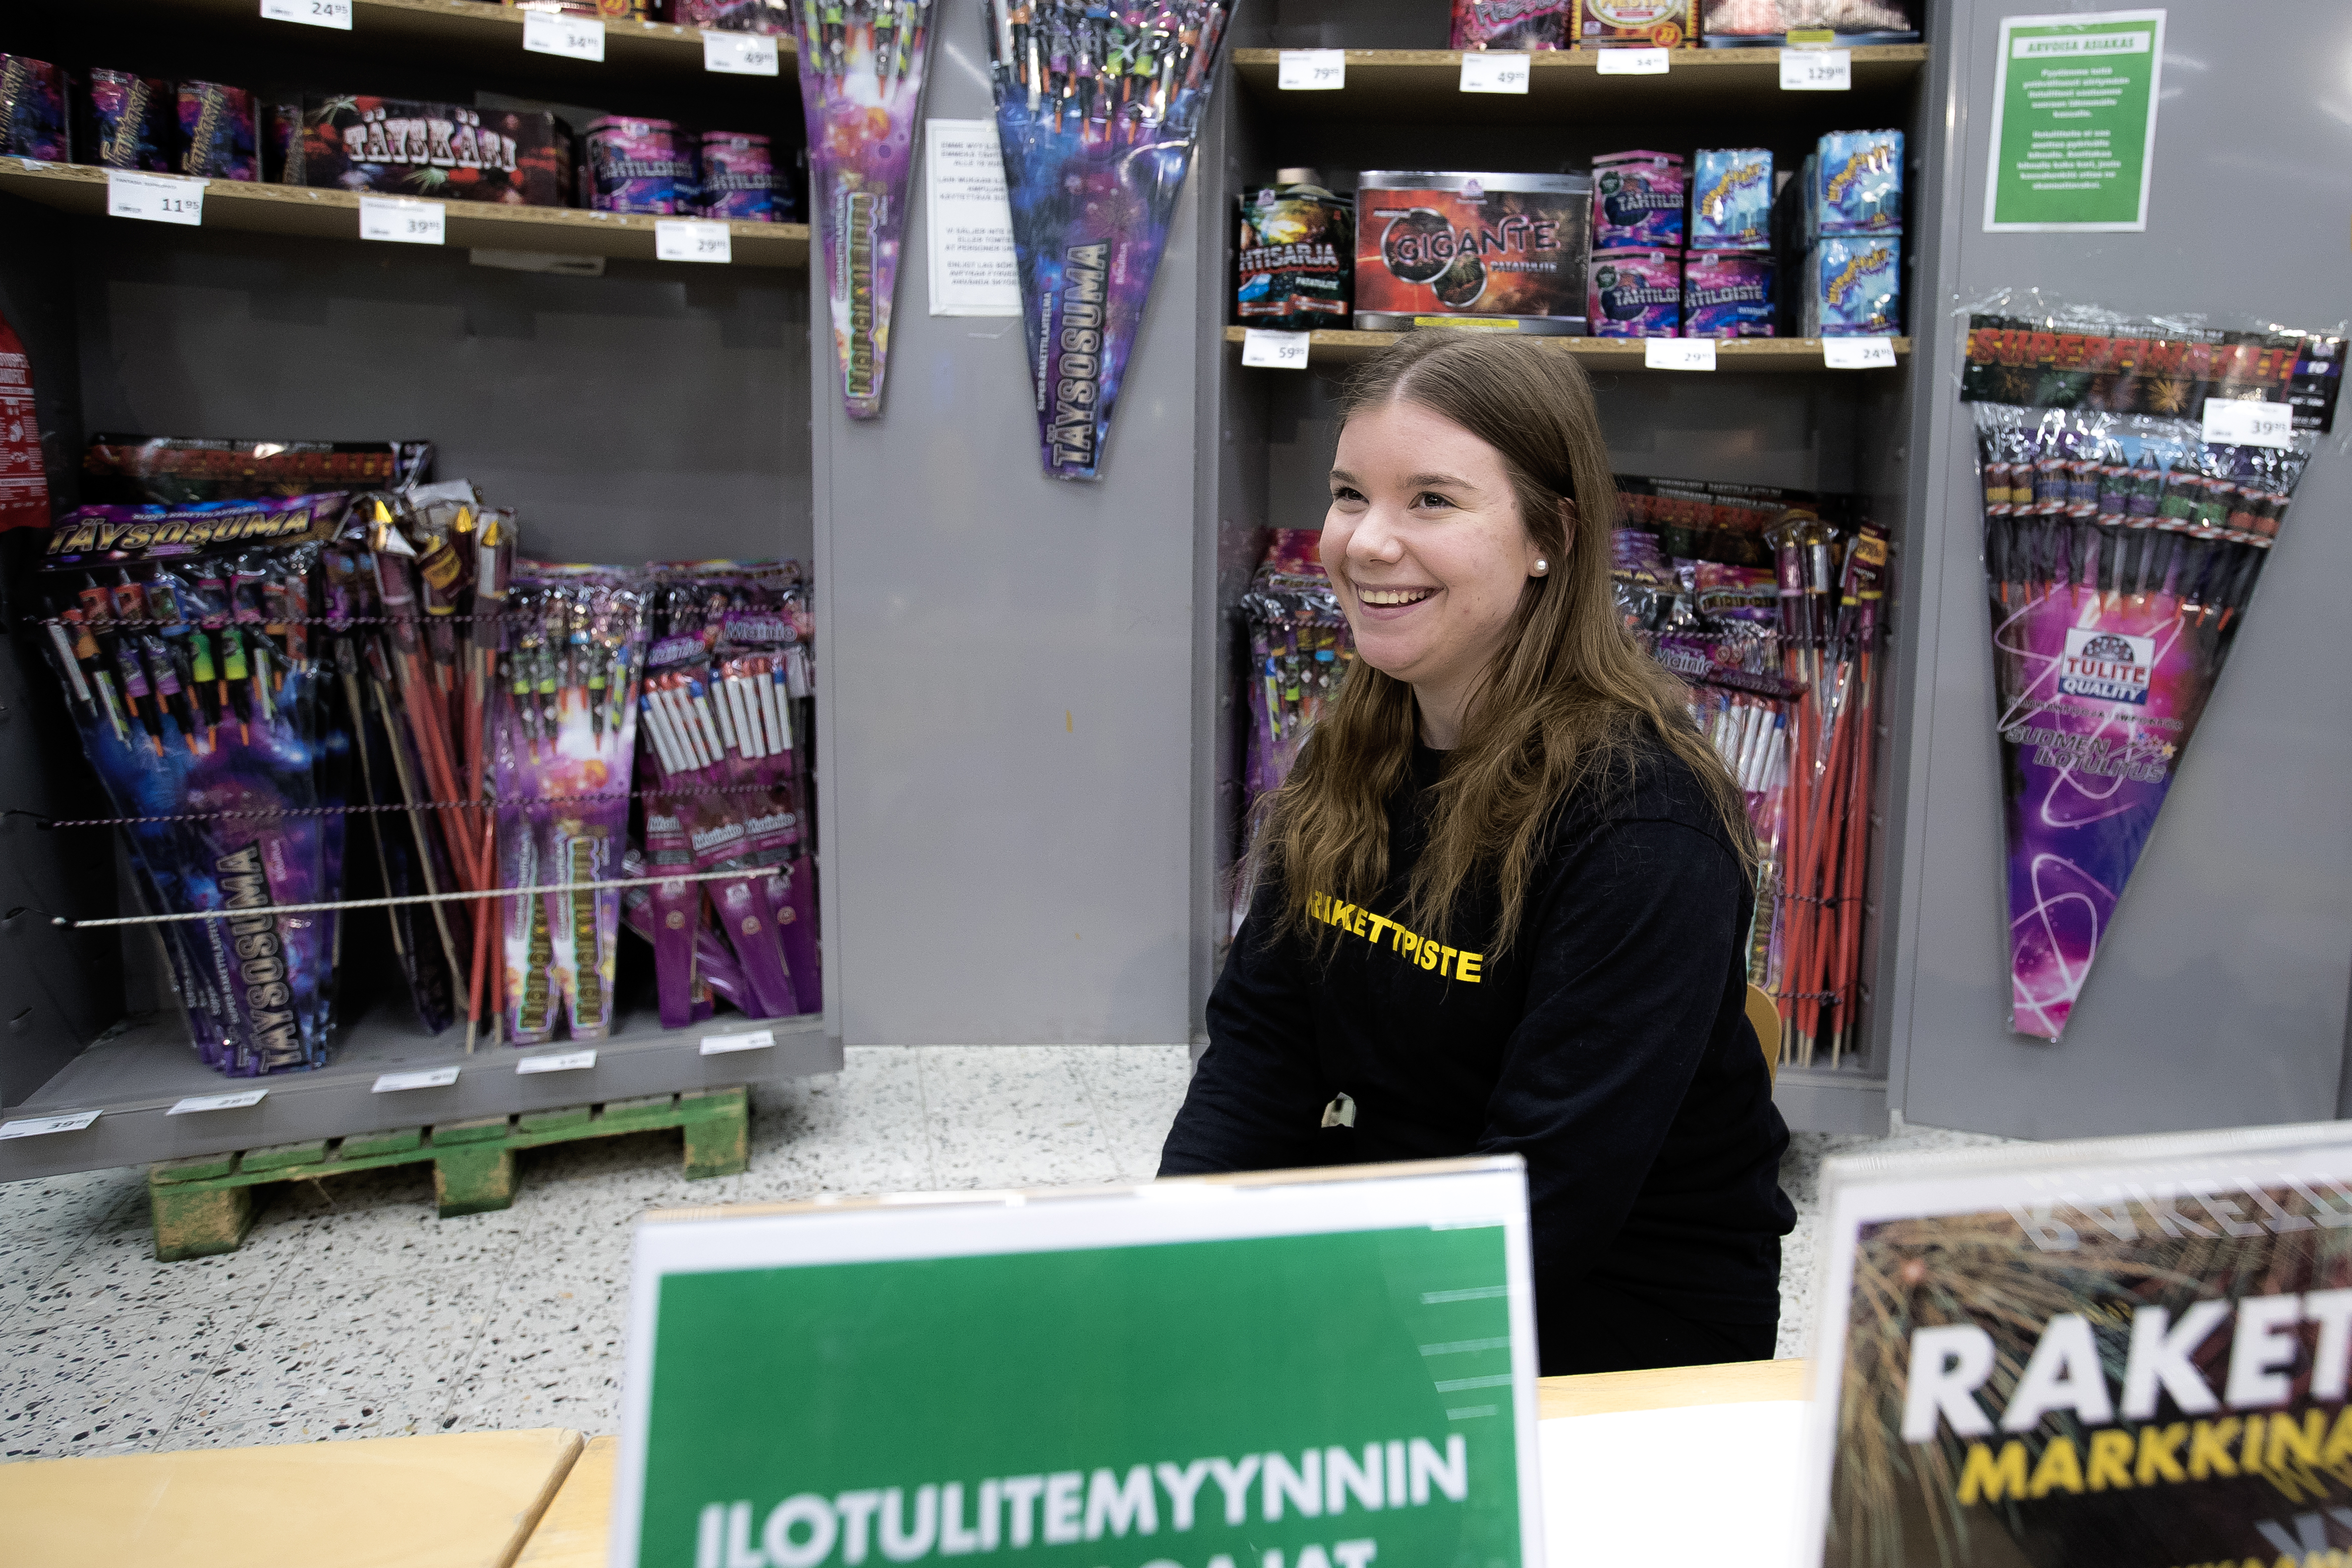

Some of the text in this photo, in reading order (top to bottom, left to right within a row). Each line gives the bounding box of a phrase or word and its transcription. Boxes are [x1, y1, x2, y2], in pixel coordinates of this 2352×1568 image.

[1396, 215, 1561, 265] GIGANTE
[1046, 243, 1108, 468] TÄYSOSUMA
[47, 509, 311, 554] TÄYSOSUMA
[2063, 677, 2141, 701] QUALITY
[2066, 657, 2147, 685] TULITE
[2005, 726, 2111, 756] SUOMEN
[2032, 748, 2167, 783] ILOTULITUS
[216, 846, 303, 1074] TÄYSOSUMA
[1901, 1287, 2352, 1445] RAKET
[695, 1433, 1467, 1568] ILOTULITEMYYNNIN
